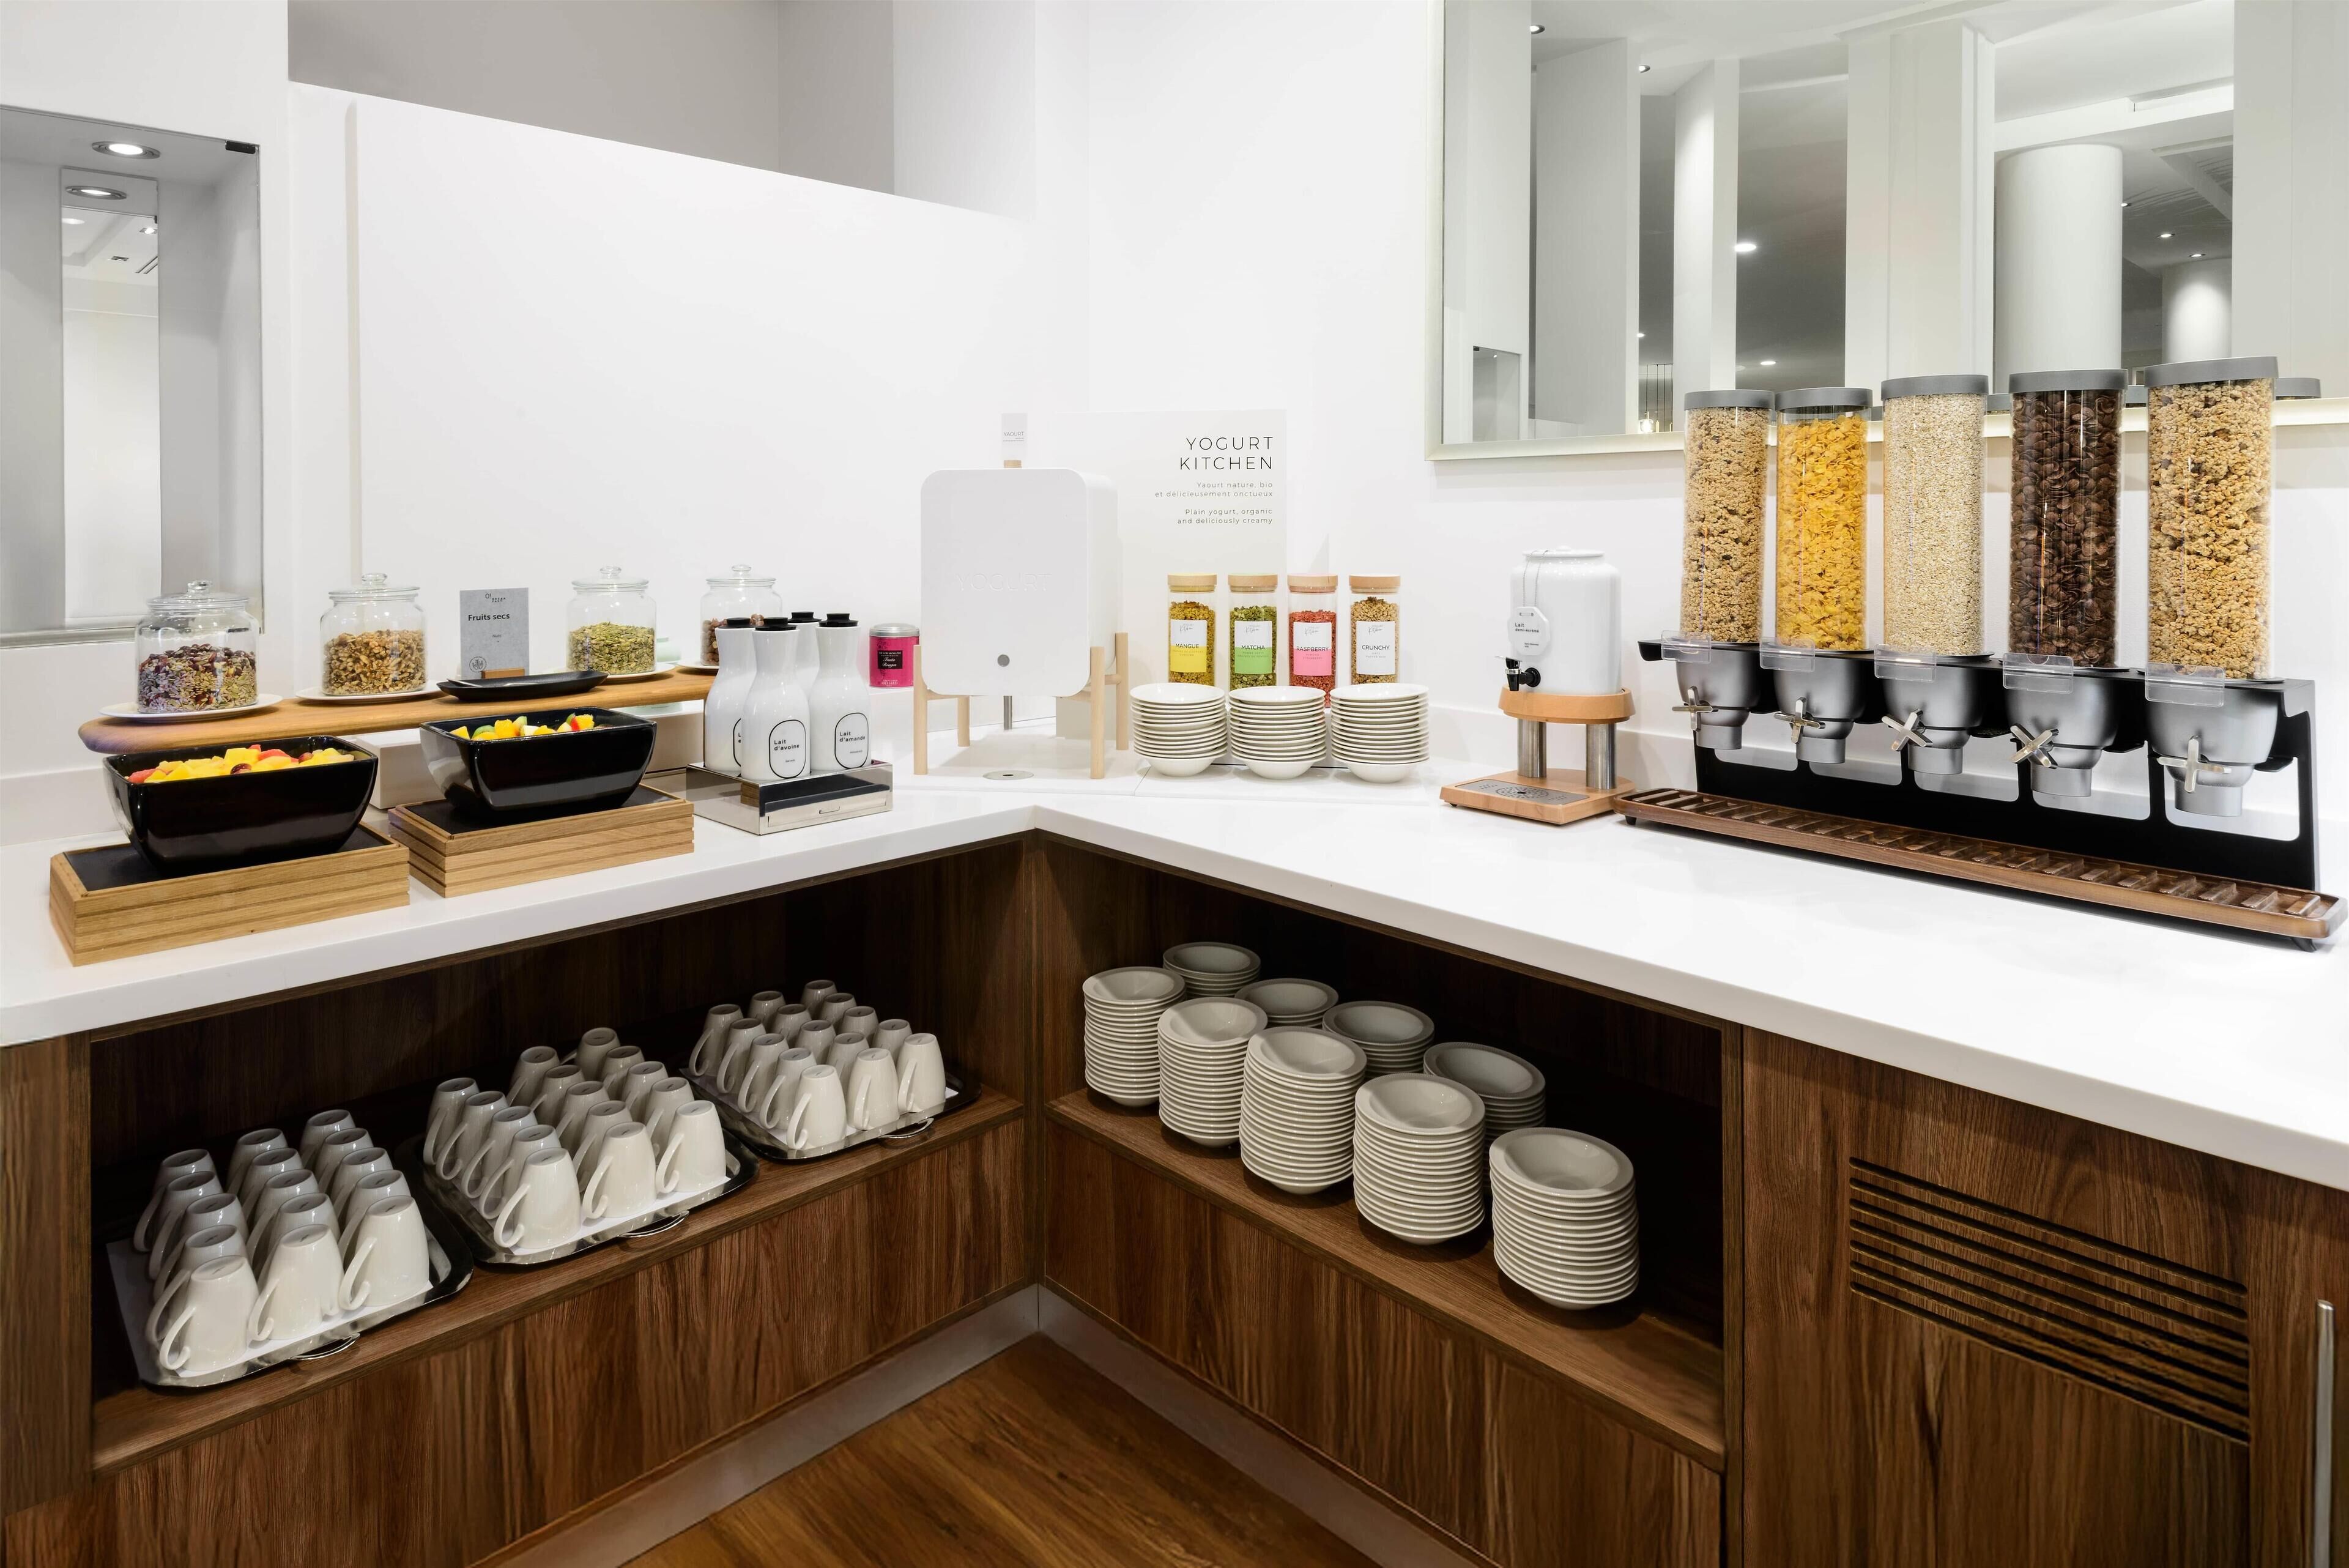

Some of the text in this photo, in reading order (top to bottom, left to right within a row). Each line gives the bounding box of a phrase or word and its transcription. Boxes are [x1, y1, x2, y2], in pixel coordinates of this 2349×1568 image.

[1186, 436, 1274, 450] YOGURT
[1180, 456, 1272, 470] KITCHEN
[956, 572, 1053, 592] YOGURT
